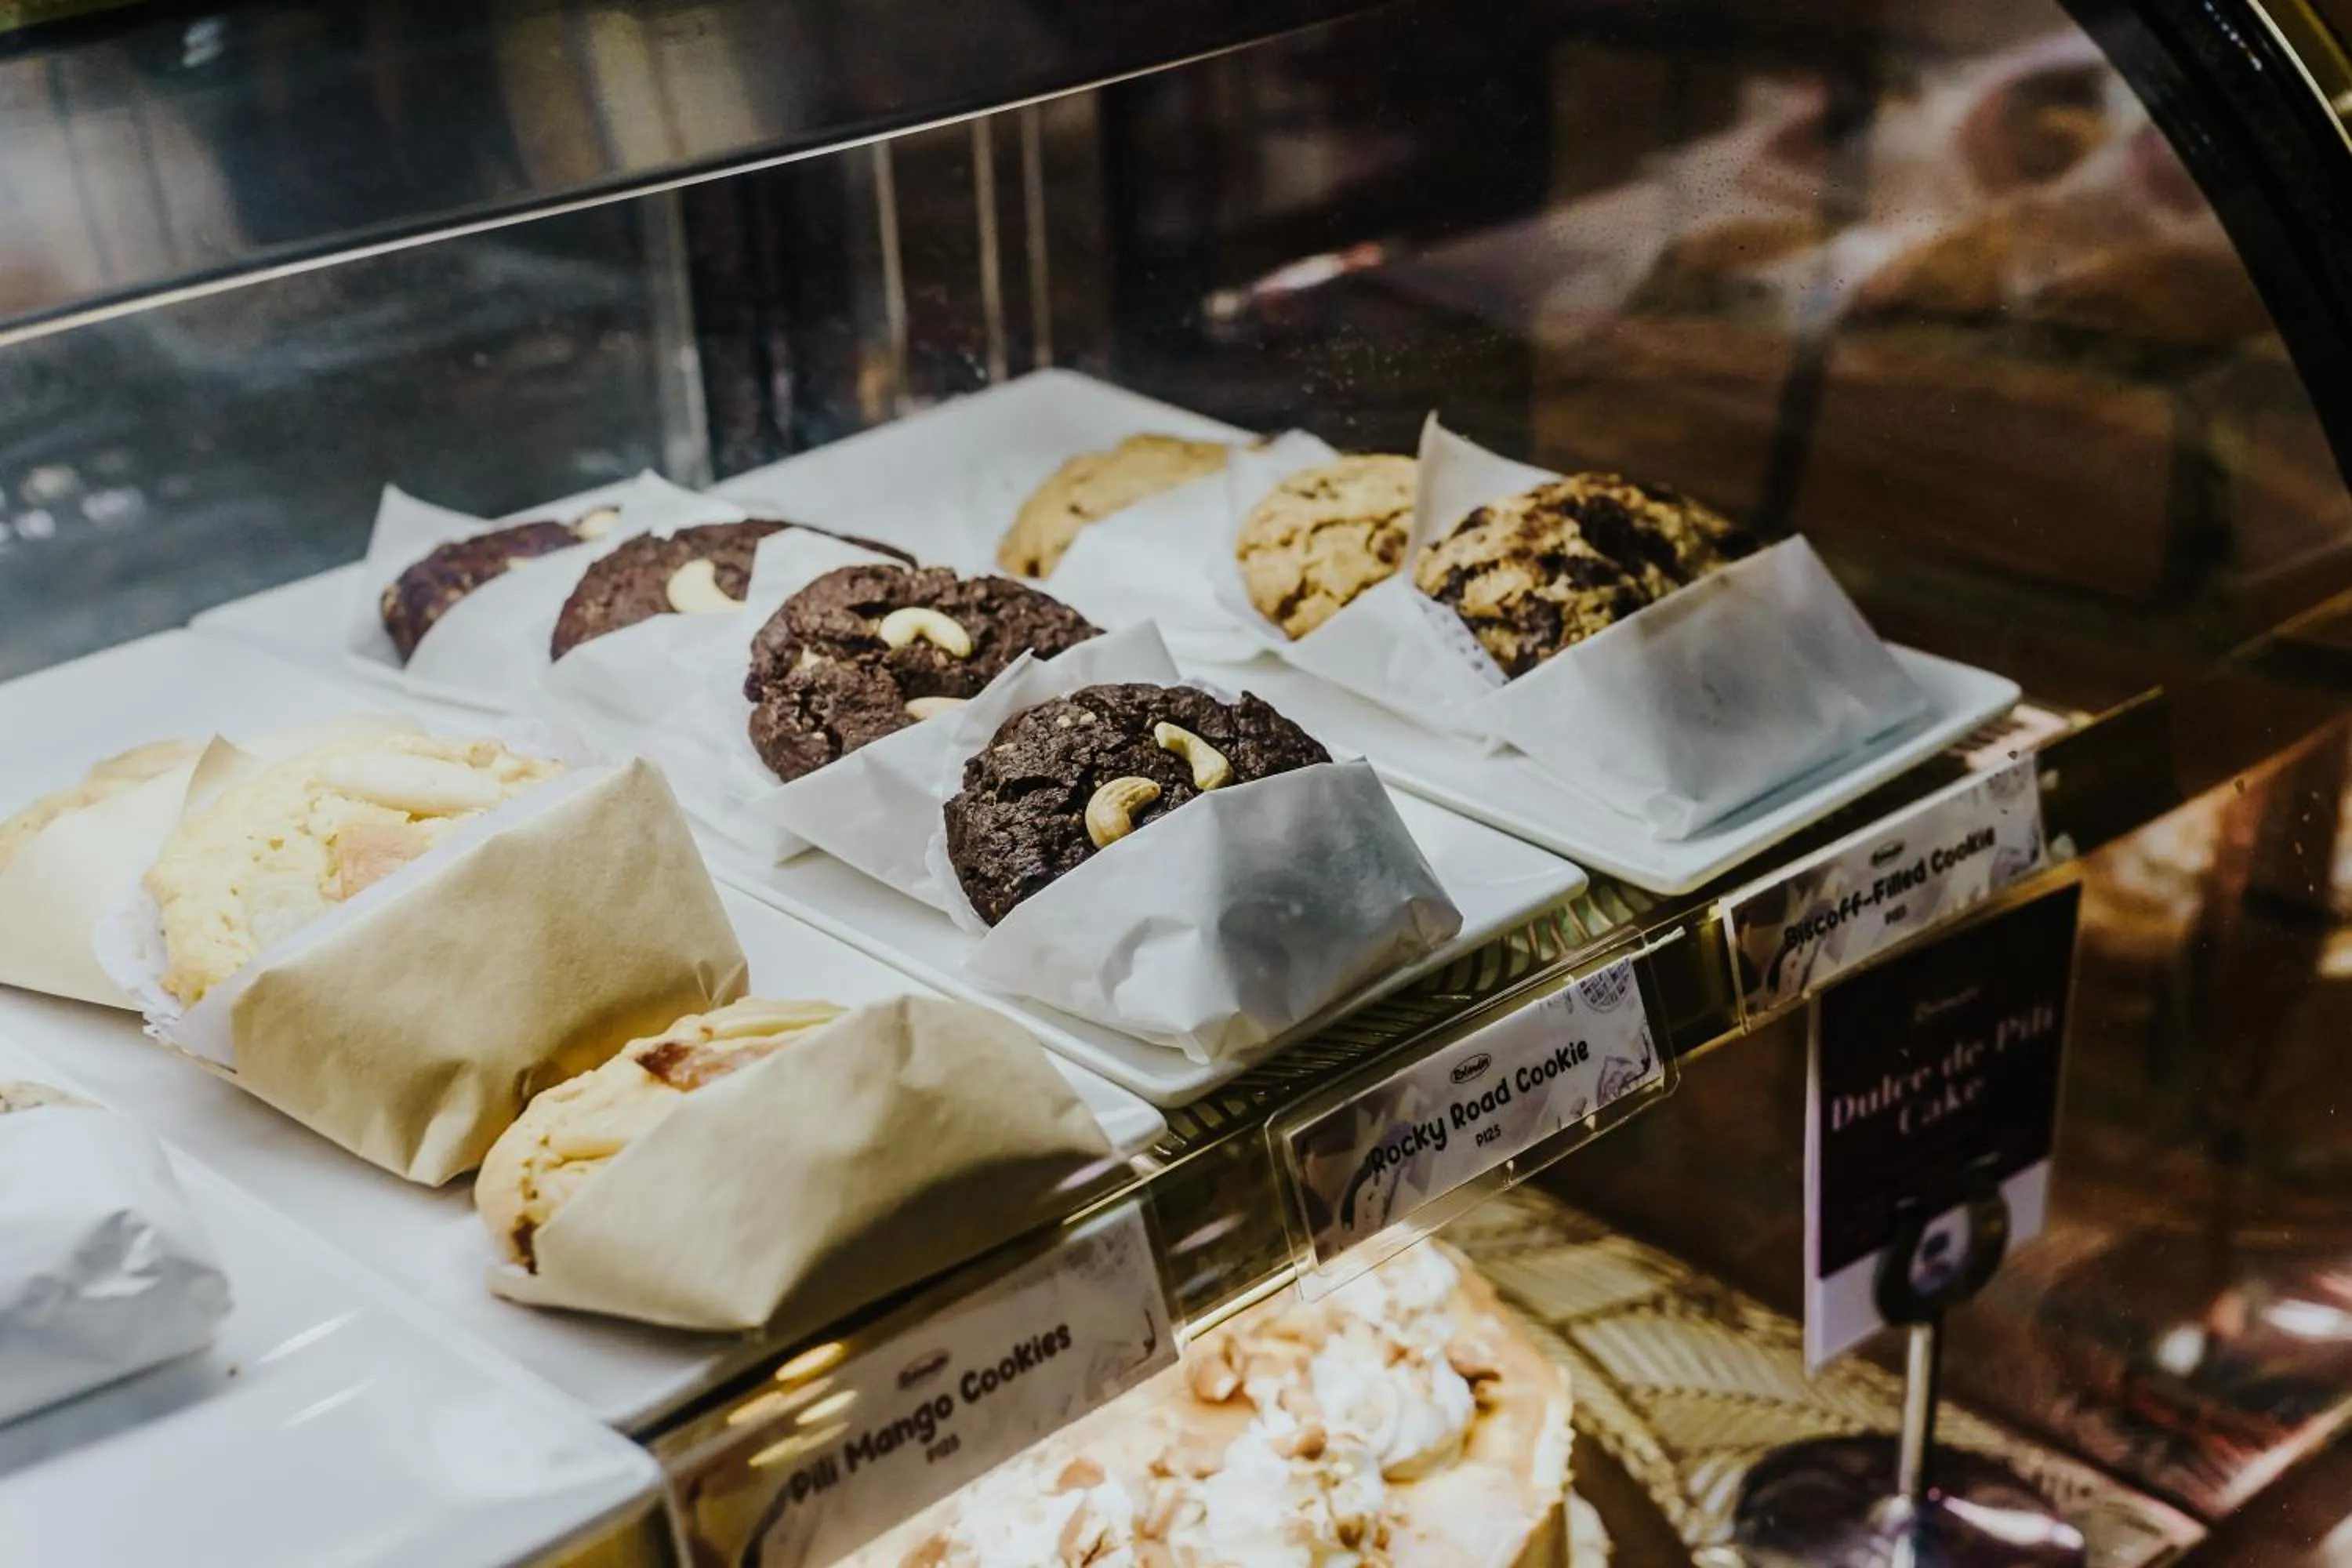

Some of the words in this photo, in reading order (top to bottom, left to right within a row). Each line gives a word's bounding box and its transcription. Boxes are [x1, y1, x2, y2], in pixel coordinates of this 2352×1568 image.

[1783, 858, 1927, 950] Biscoff-Filled
[1930, 827, 1996, 874] Cookie
[1371, 1117, 1446, 1172] Rocky
[1450, 1076, 1512, 1130] Road
[1515, 1040, 1589, 1094] Cookie
[1831, 1065, 1933, 1133] Dulce
[1940, 1039, 1985, 1078] de
[1898, 1076, 1984, 1135] Cake
[787, 1455, 839, 1504] Pili
[842, 1394, 953, 1472] Mango
[960, 1323, 1073, 1403] Cookies
